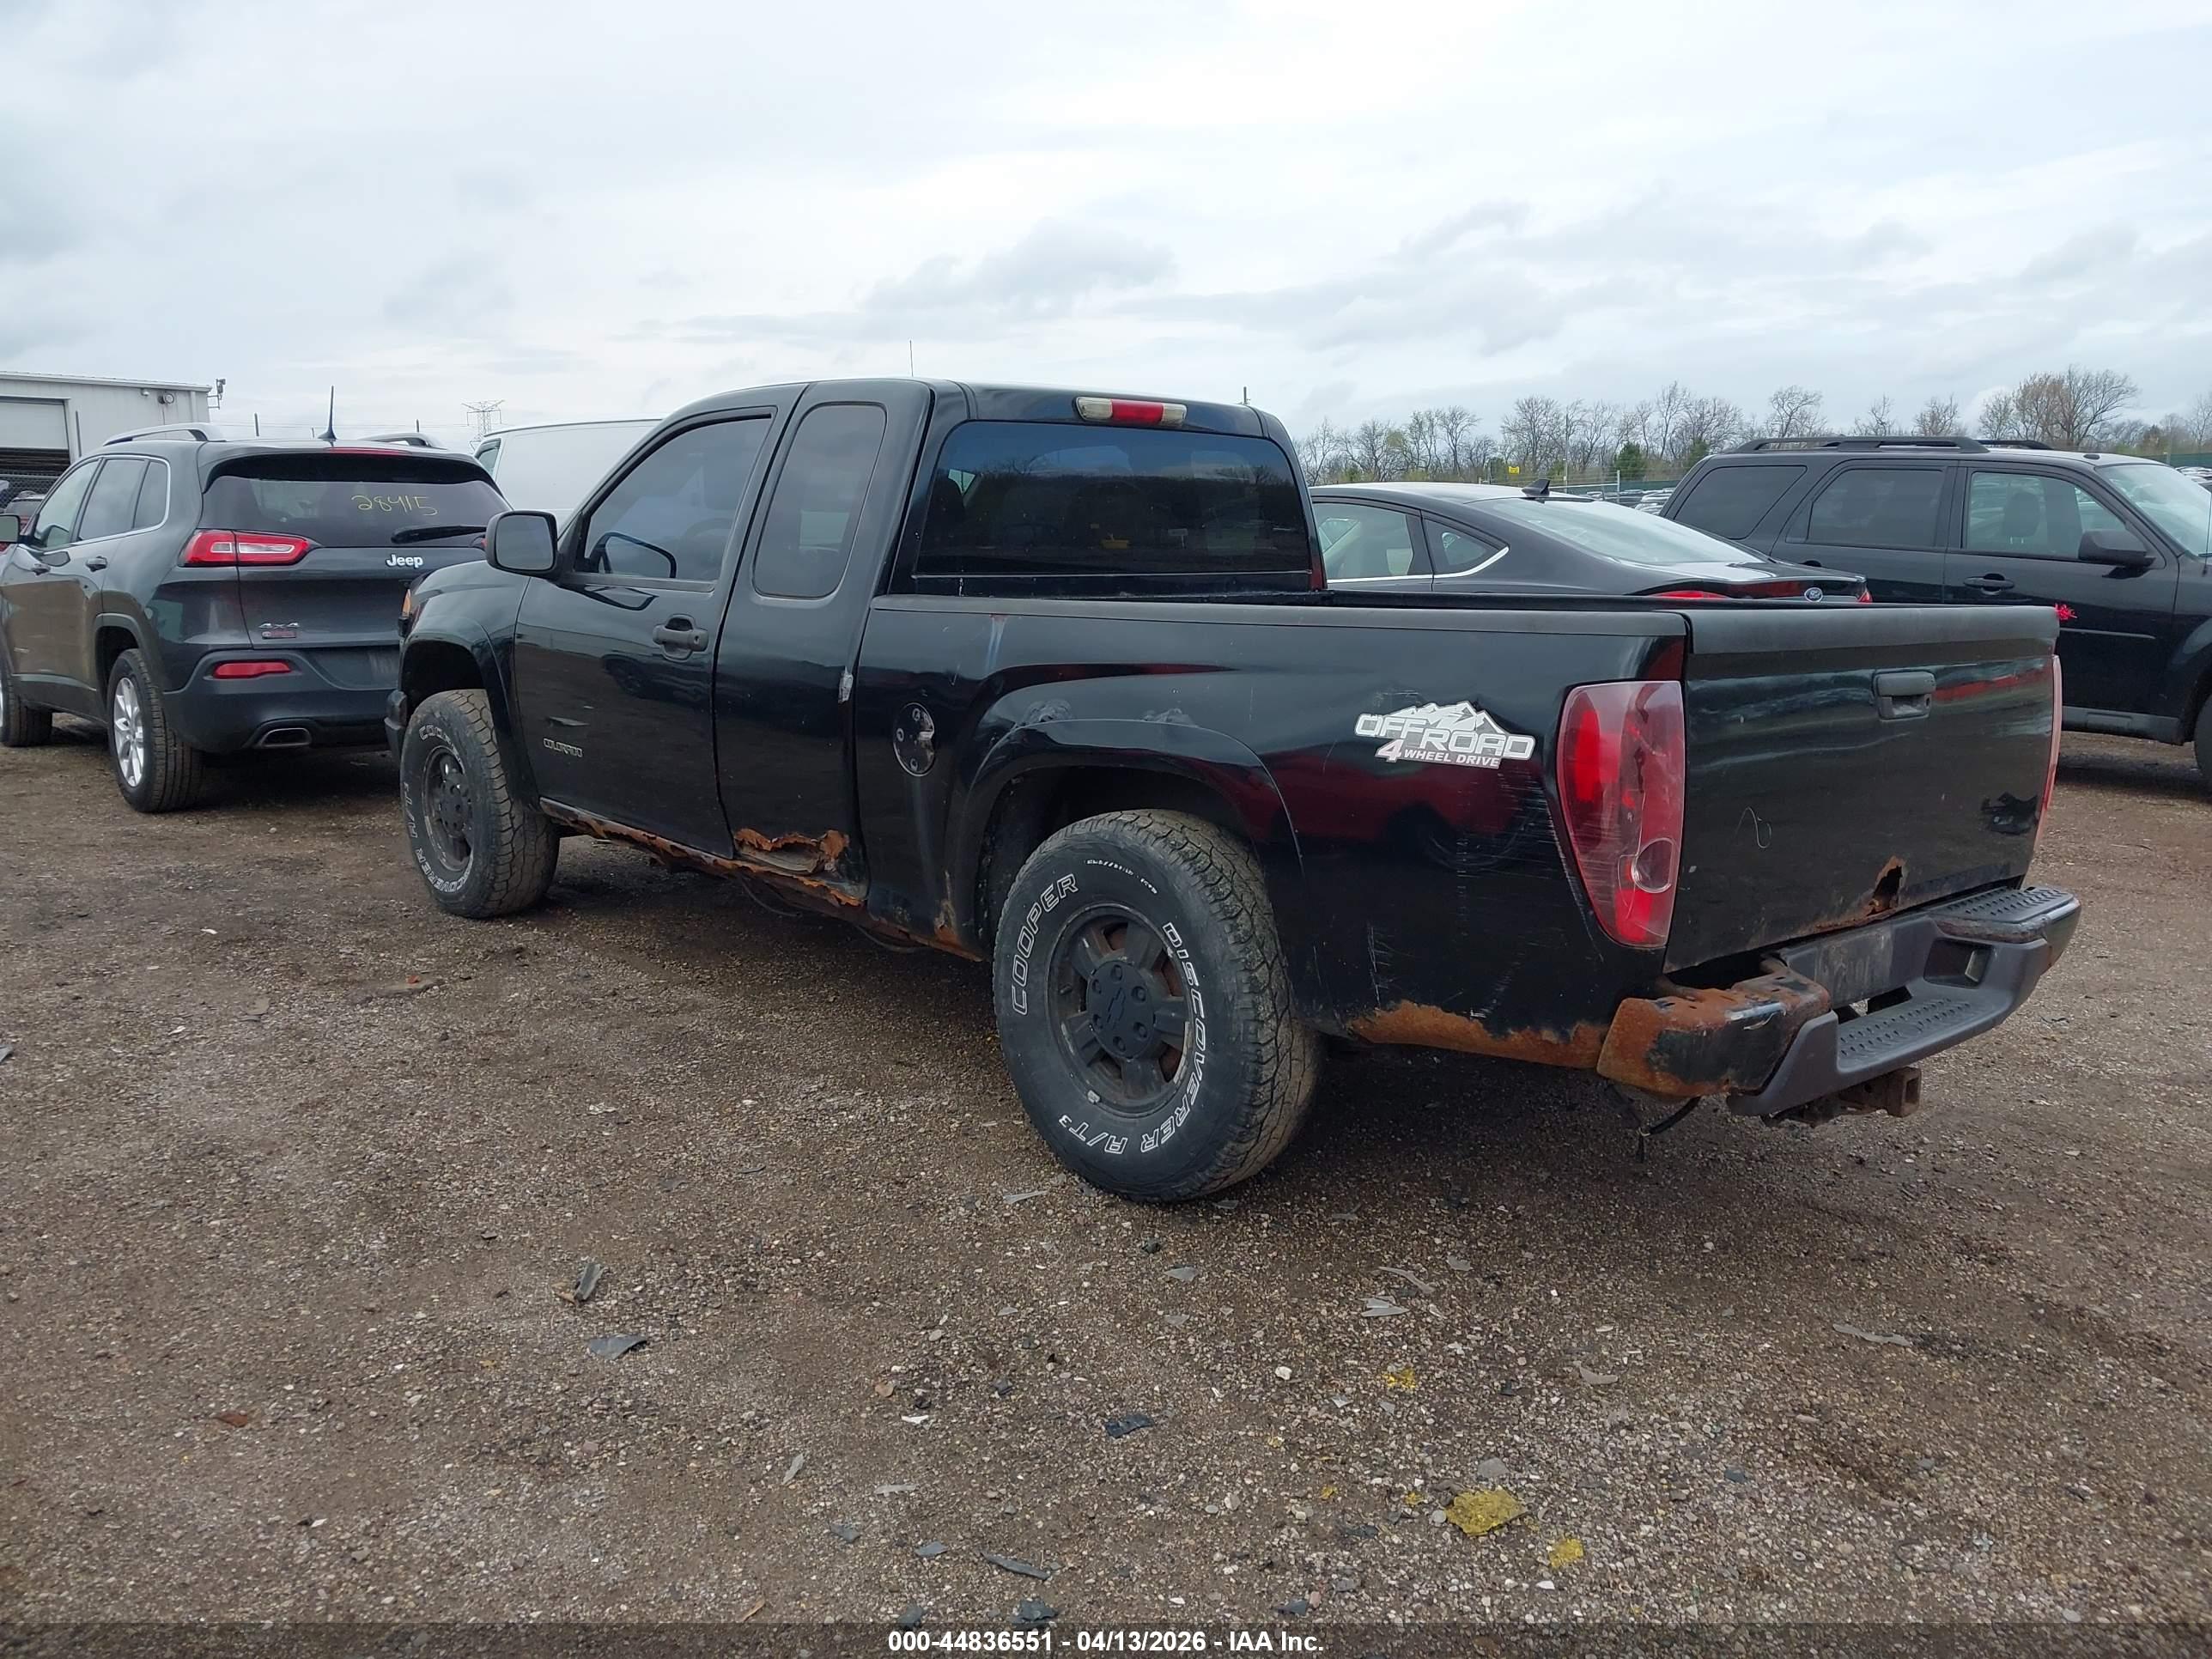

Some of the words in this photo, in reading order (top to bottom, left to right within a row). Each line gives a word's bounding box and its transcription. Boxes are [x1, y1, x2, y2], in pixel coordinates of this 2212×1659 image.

[351, 495, 438, 516] 28415
[386, 554, 423, 568] Jeep
[1355, 714, 1427, 739] OFF
[1419, 729, 1535, 761] ROAD
[1375, 739, 1405, 763] 4
[1404, 748, 1451, 763] WHEEL
[1455, 754, 1500, 769] DRIVE
[1012, 873, 1079, 1016] COOPER
[1139, 922, 1206, 1153] DISCOVERER
